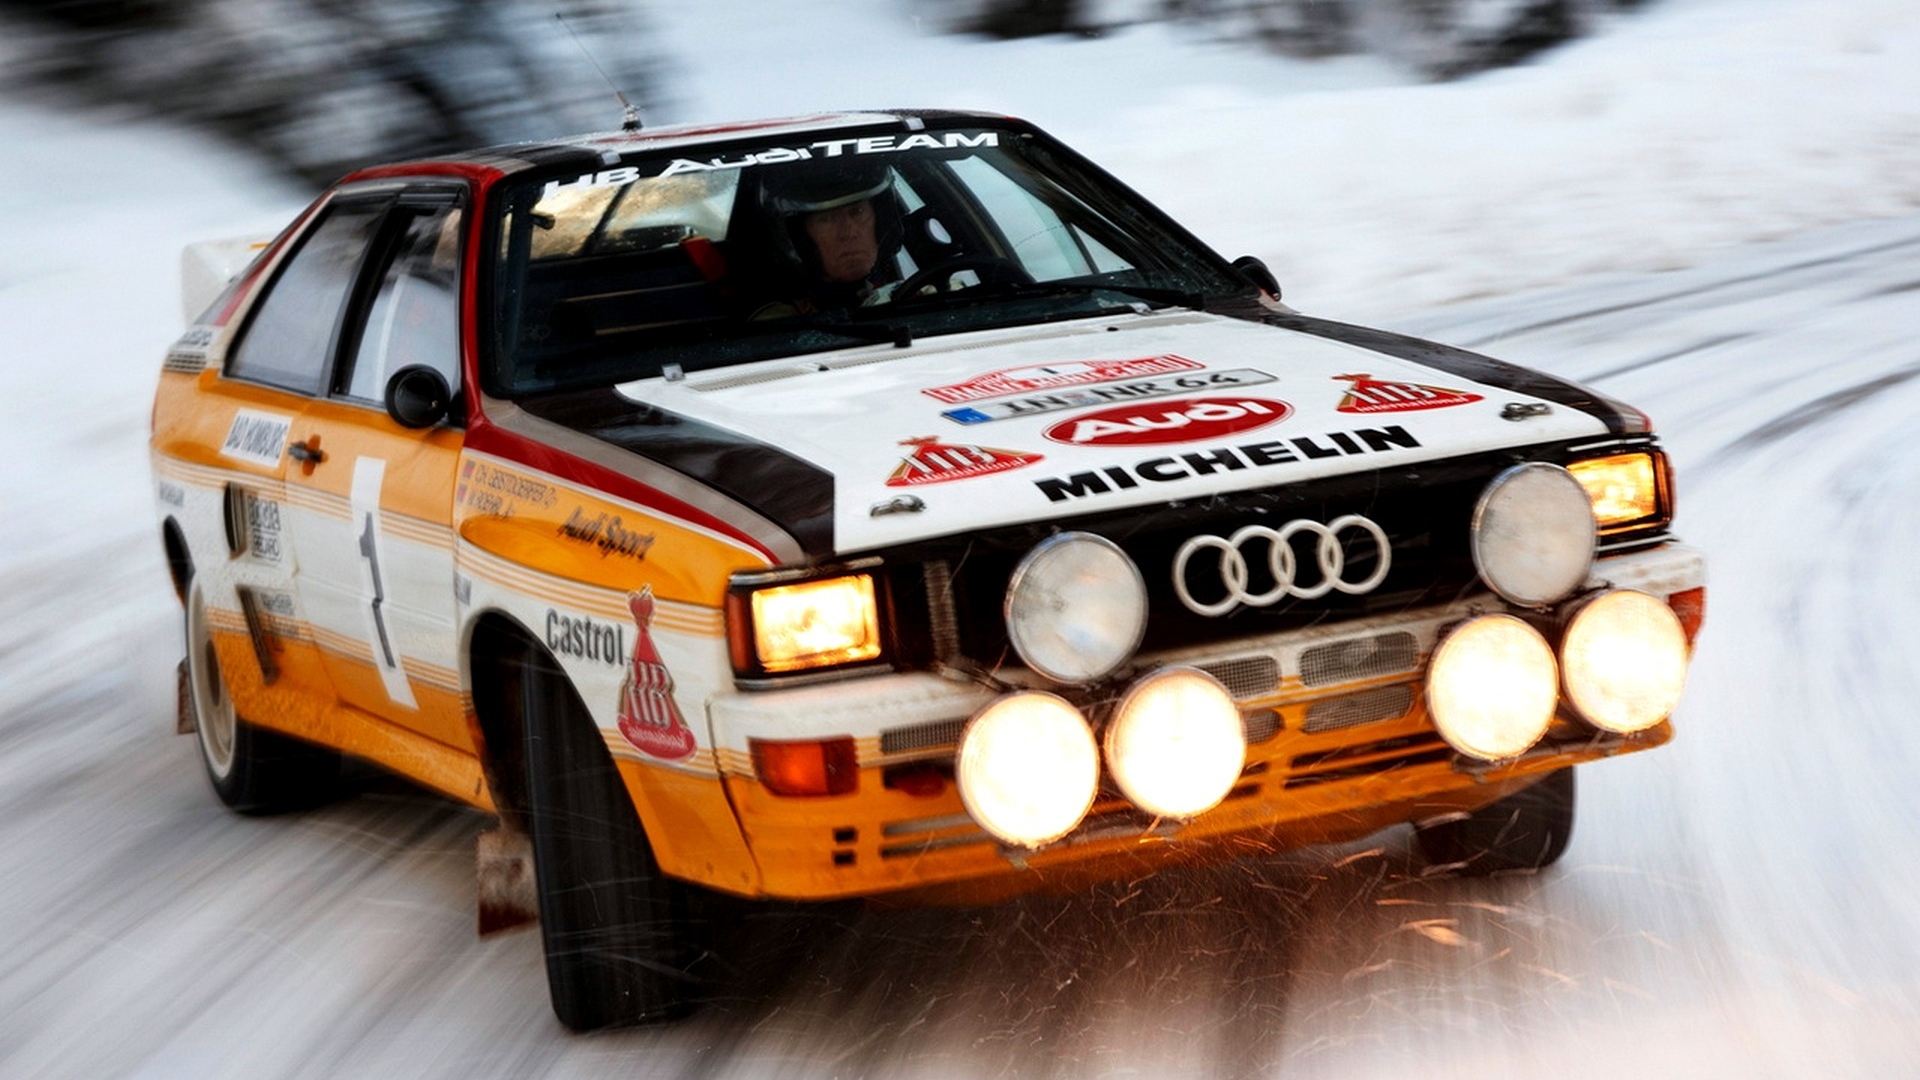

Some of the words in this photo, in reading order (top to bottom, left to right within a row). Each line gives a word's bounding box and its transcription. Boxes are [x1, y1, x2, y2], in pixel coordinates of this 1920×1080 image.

[543, 166, 641, 200] HB
[811, 132, 999, 157] TEAM
[1002, 394, 1069, 414] IN
[1090, 380, 1169, 400] NR
[1175, 373, 1240, 388] 64
[1345, 383, 1438, 405] HB
[902, 444, 996, 474] HB
[1031, 425, 1422, 502] MICHELIN
[556, 505, 607, 545] Audi
[597, 515, 657, 561] Sport
[358, 511, 397, 668] 1
[546, 608, 625, 666] Castrol
[626, 660, 674, 729] HB
